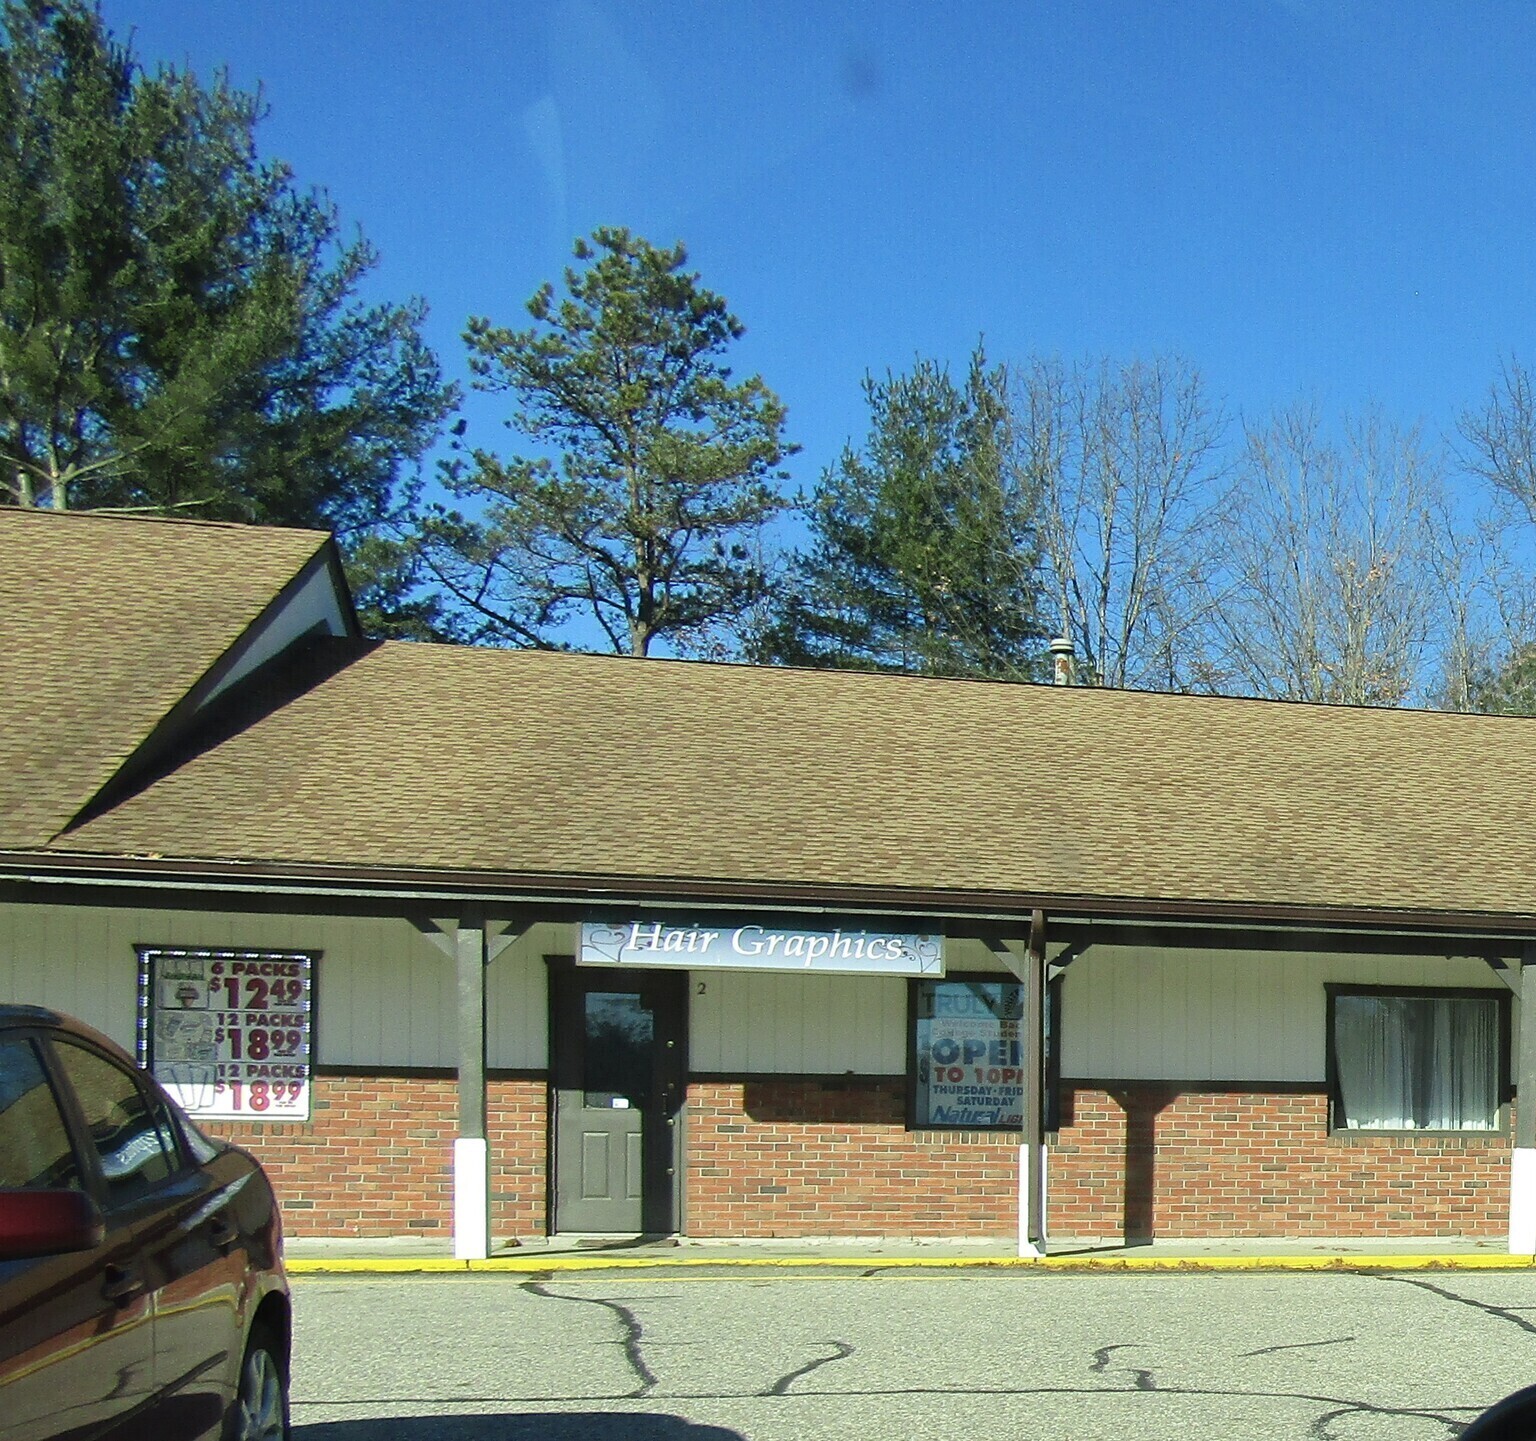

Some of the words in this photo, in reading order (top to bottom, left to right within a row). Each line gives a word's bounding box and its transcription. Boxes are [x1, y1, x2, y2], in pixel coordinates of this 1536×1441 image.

[624, 920, 718, 951] Hair
[732, 924, 903, 967] Graphics
[211, 962, 224, 975] 6
[232, 963, 301, 977] PACKS
[697, 982, 706, 995] 2
[218, 1013, 239, 1026] 12
[246, 1014, 305, 1028] PACKS
[219, 1065, 240, 1077] 12
[247, 1065, 307, 1079] PACKS
[934, 1066, 964, 1083] TO
[999, 1086, 1024, 1096] FRID
[956, 1096, 1015, 1106] SATURDAY
[931, 1105, 1000, 1124] Natural
